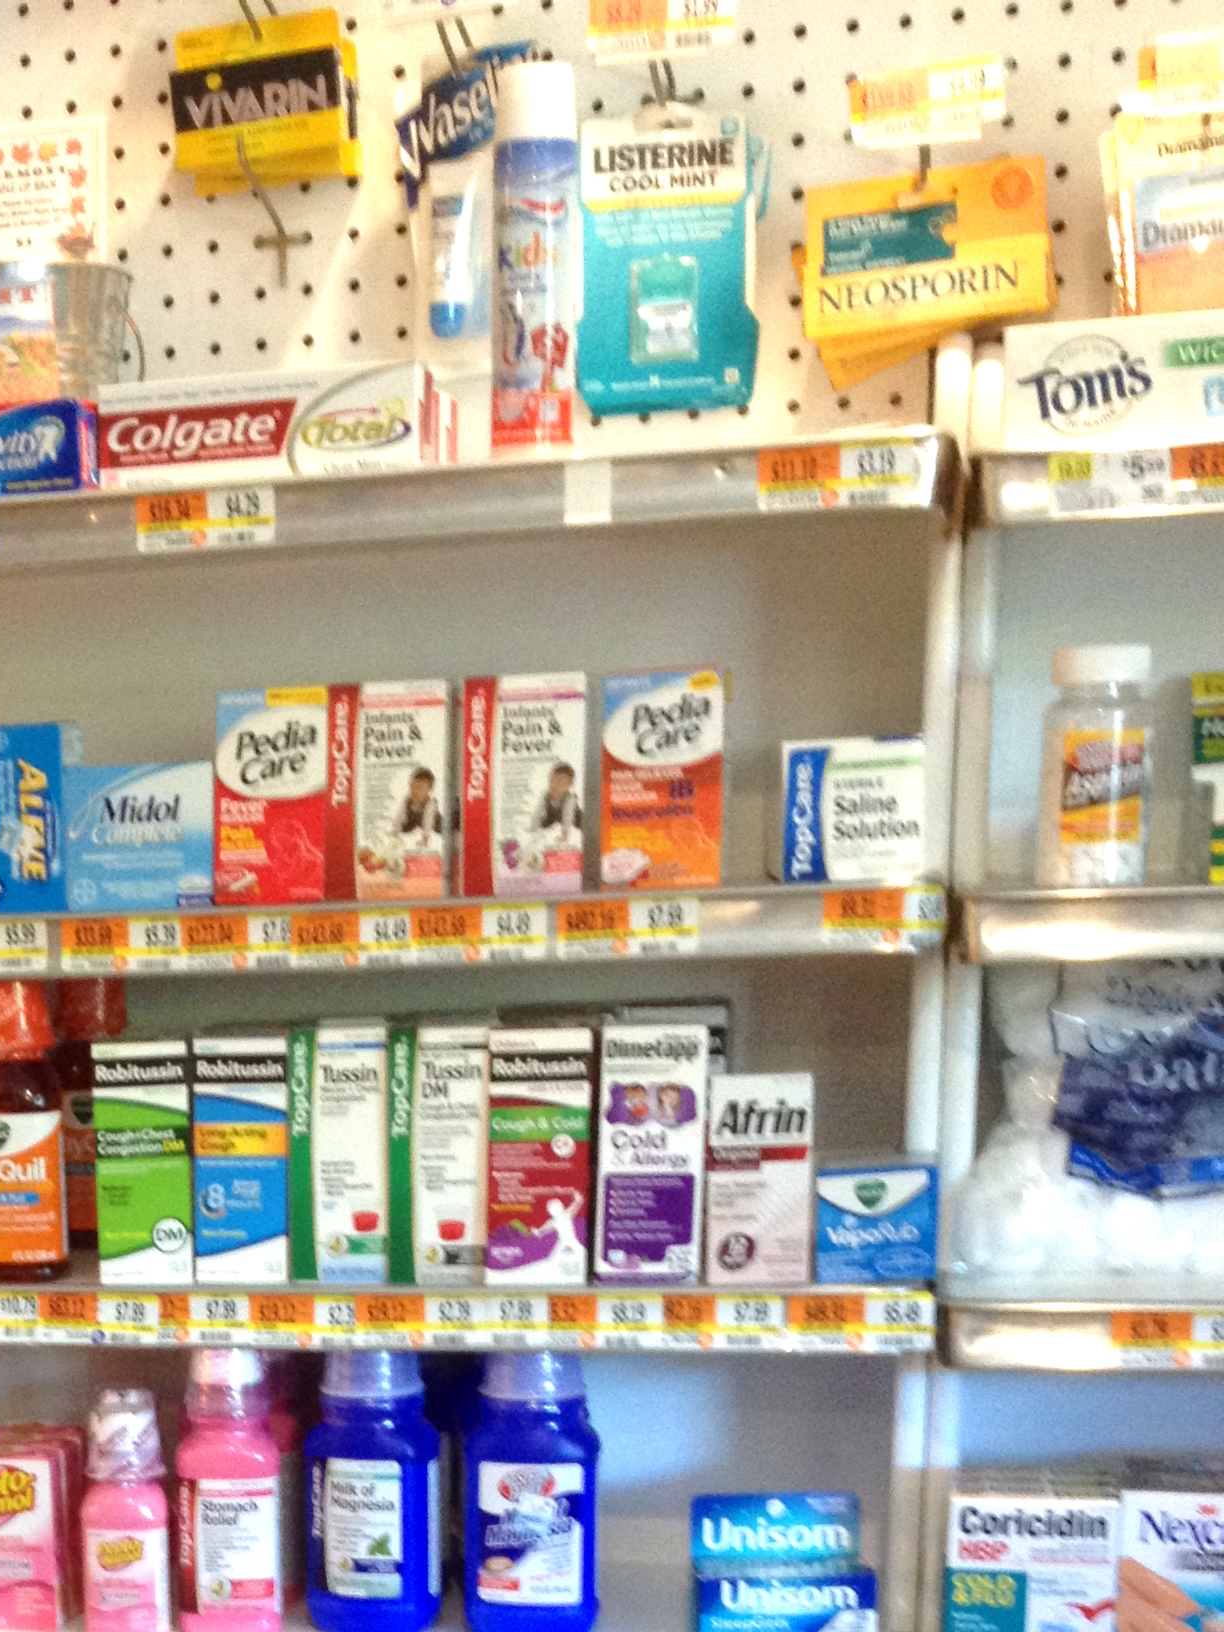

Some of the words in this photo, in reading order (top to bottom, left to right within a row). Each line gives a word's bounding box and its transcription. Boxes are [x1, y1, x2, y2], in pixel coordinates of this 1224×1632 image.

[185, 74, 328, 130] VIVARIN
[593, 138, 734, 175] LISTERINE
[609, 175, 663, 193] COOL
[671, 171, 718, 188] MINT
[816, 260, 1020, 316] NEOSPORIN
[1018, 350, 1154, 421] Tom's
[106, 410, 278, 458] Colgate
[302, 416, 401, 449] Total
[500, 720, 545, 738] Pain
[548, 718, 562, 736] &
[630, 692, 714, 733] Pedia
[235, 719, 318, 761] Pedia
[363, 724, 404, 743] Pain
[408, 722, 422, 742] &
[466, 685, 487, 803] TopCare
[500, 735, 553, 754] Fever
[635, 719, 702, 756] Care
[331, 692, 350, 807] TopCare
[362, 741, 414, 760] Fever
[239, 750, 307, 788] Care
[99, 793, 180, 825] Midol
[792, 761, 814, 880] TopCare
[833, 793, 899, 819] Saline
[833, 819, 921, 843] Solution
[605, 1038, 699, 1063] Dimetapp
[94, 1062, 183, 1082] Robitussin
[196, 1059, 284, 1080] Robitussin
[319, 1063, 378, 1084] Tussin
[422, 1061, 482, 1083] Tussin
[492, 1056, 588, 1080] Robitussin
[292, 1034, 310, 1137] TopCare
[391, 1035, 410, 1137] TopCare
[421, 1082, 450, 1099] DM
[714, 1099, 807, 1138] Afrin
[611, 1129, 668, 1151] Cold
[330, 1479, 357, 1497] Milk
[200, 1499, 259, 1515] Stomach
[200, 1514, 240, 1527] Relief
[331, 1494, 397, 1515] Magnesia
[177, 1478, 193, 1571] TopCare
[701, 1516, 853, 1555] Unisom
[958, 1505, 1110, 1541] Coricidin
[719, 1579, 860, 1612] Unisom
